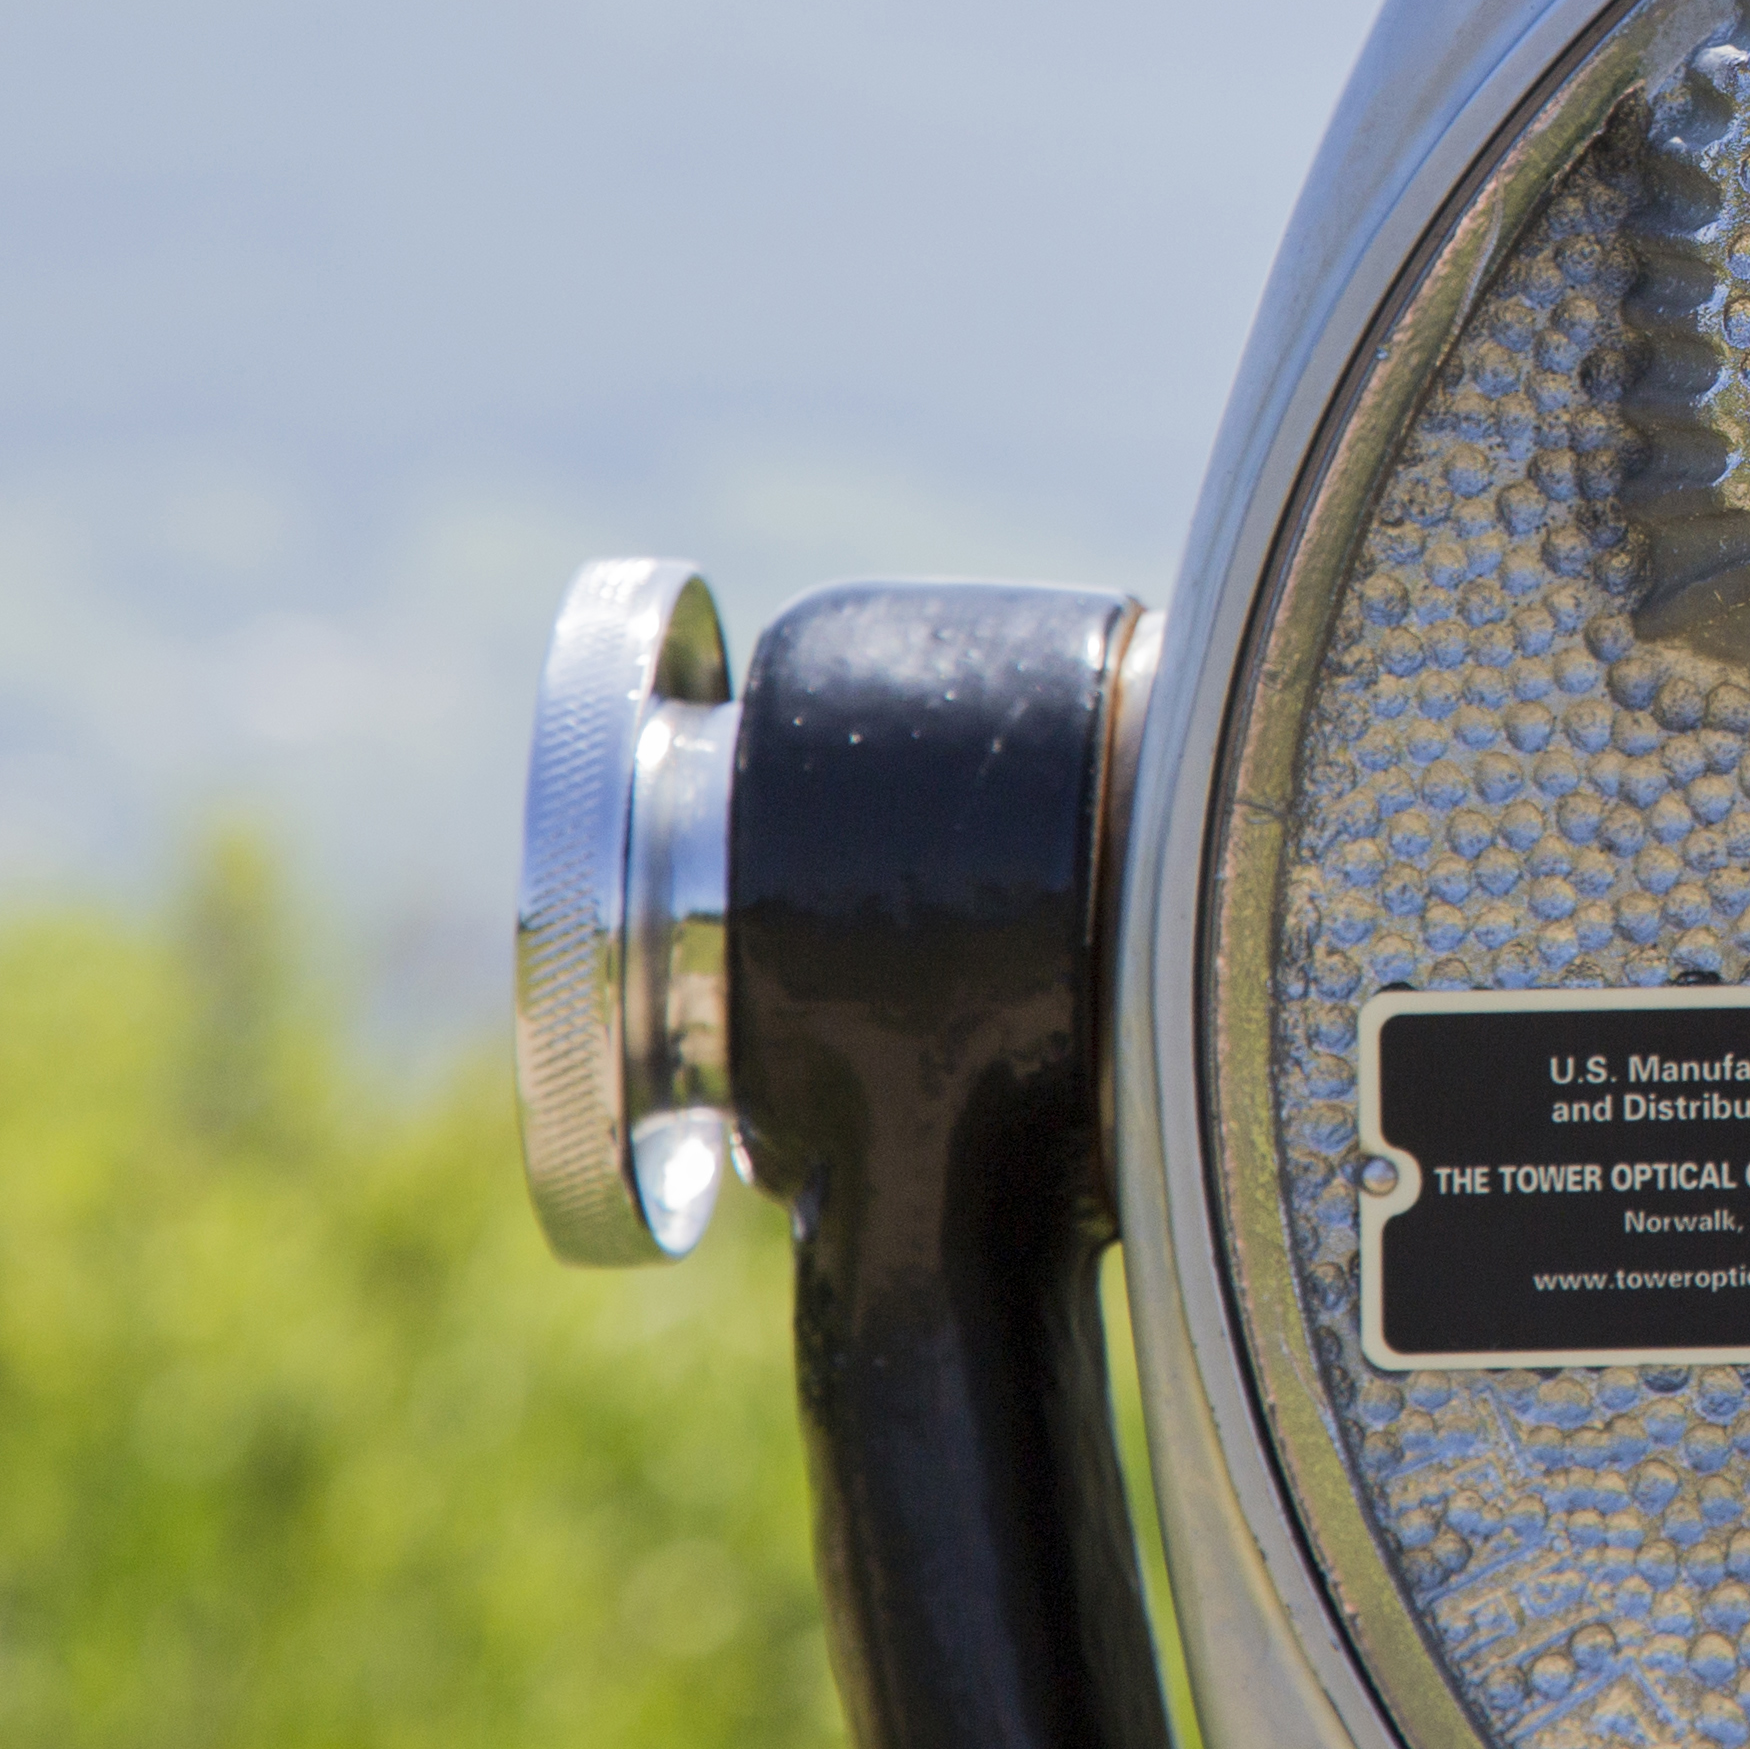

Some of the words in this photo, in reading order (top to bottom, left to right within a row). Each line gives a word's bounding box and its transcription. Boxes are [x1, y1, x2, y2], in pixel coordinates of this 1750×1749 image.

[1550, 1055, 1617, 1085] U.S.
[1551, 1094, 1613, 1123] and
[1433, 1165, 1490, 1195] THE
[1497, 1163, 1603, 1194] TOWER
[1610, 1161, 1738, 1192] OPTICAL
[1624, 1209, 1743, 1233] Norwalk,
